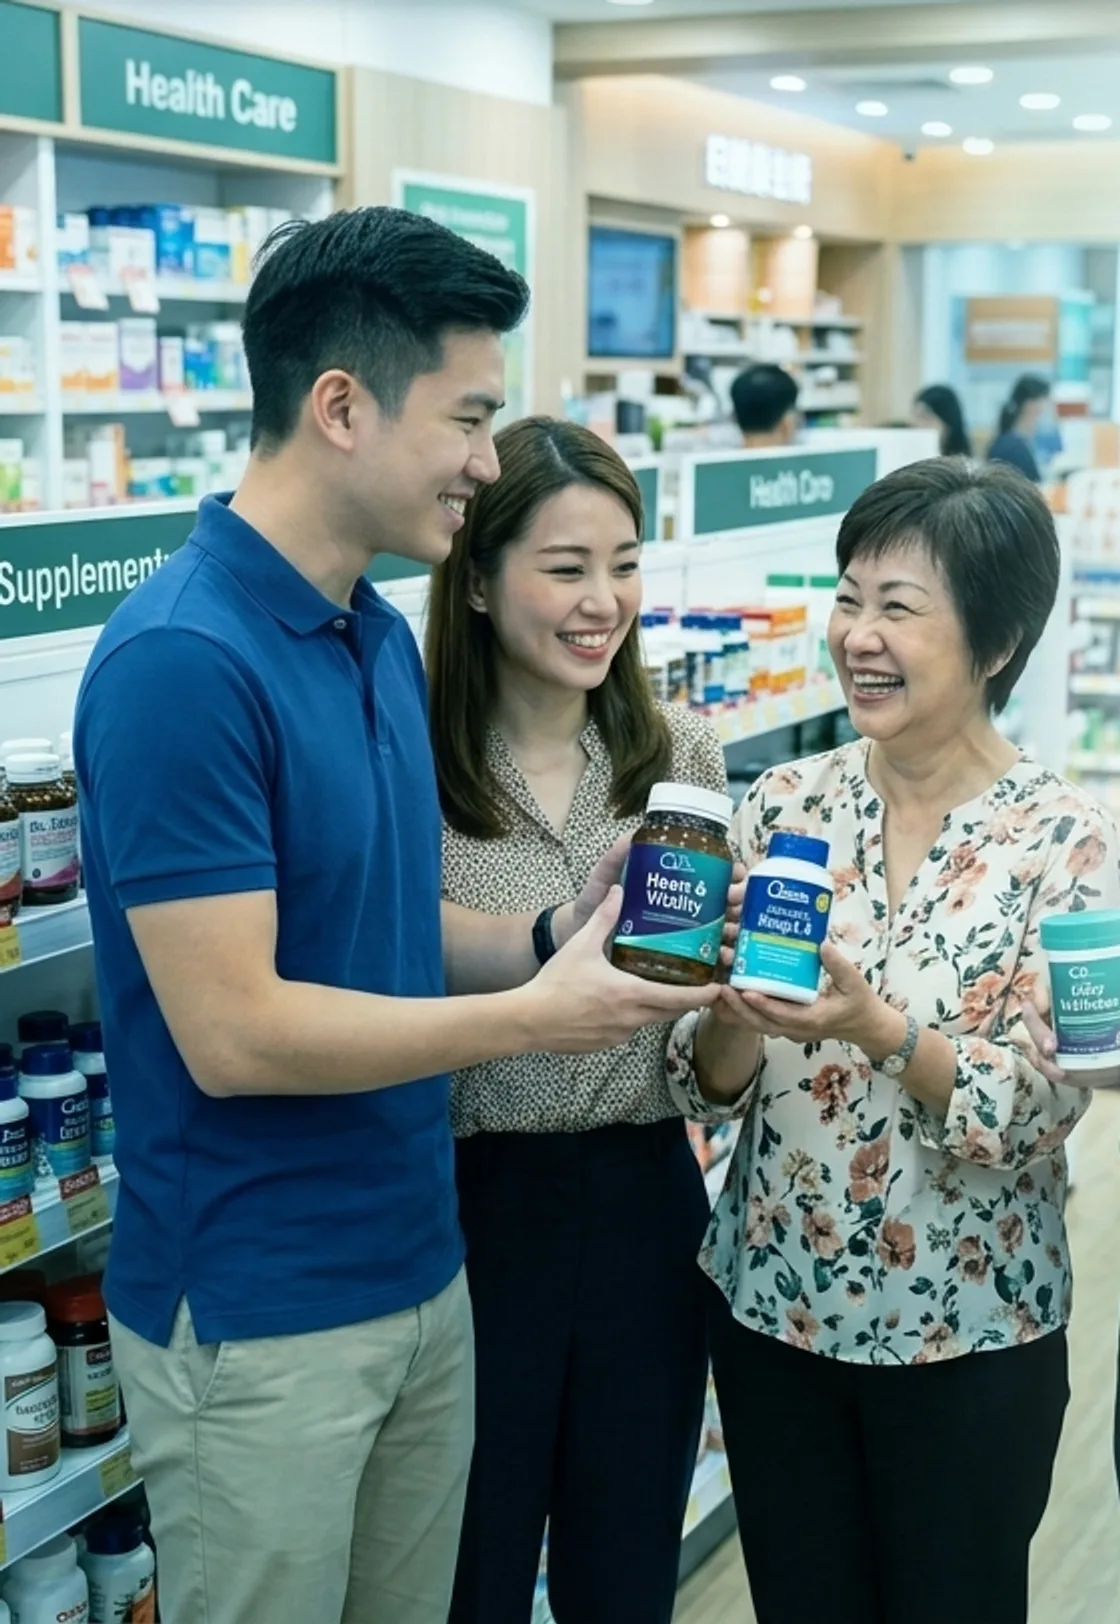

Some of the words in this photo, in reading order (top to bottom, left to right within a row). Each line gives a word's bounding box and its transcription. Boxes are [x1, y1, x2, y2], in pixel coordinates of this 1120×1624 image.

[126, 59, 225, 120] Health
[231, 78, 297, 132] Care
[0, 547, 170, 612] Supplement
